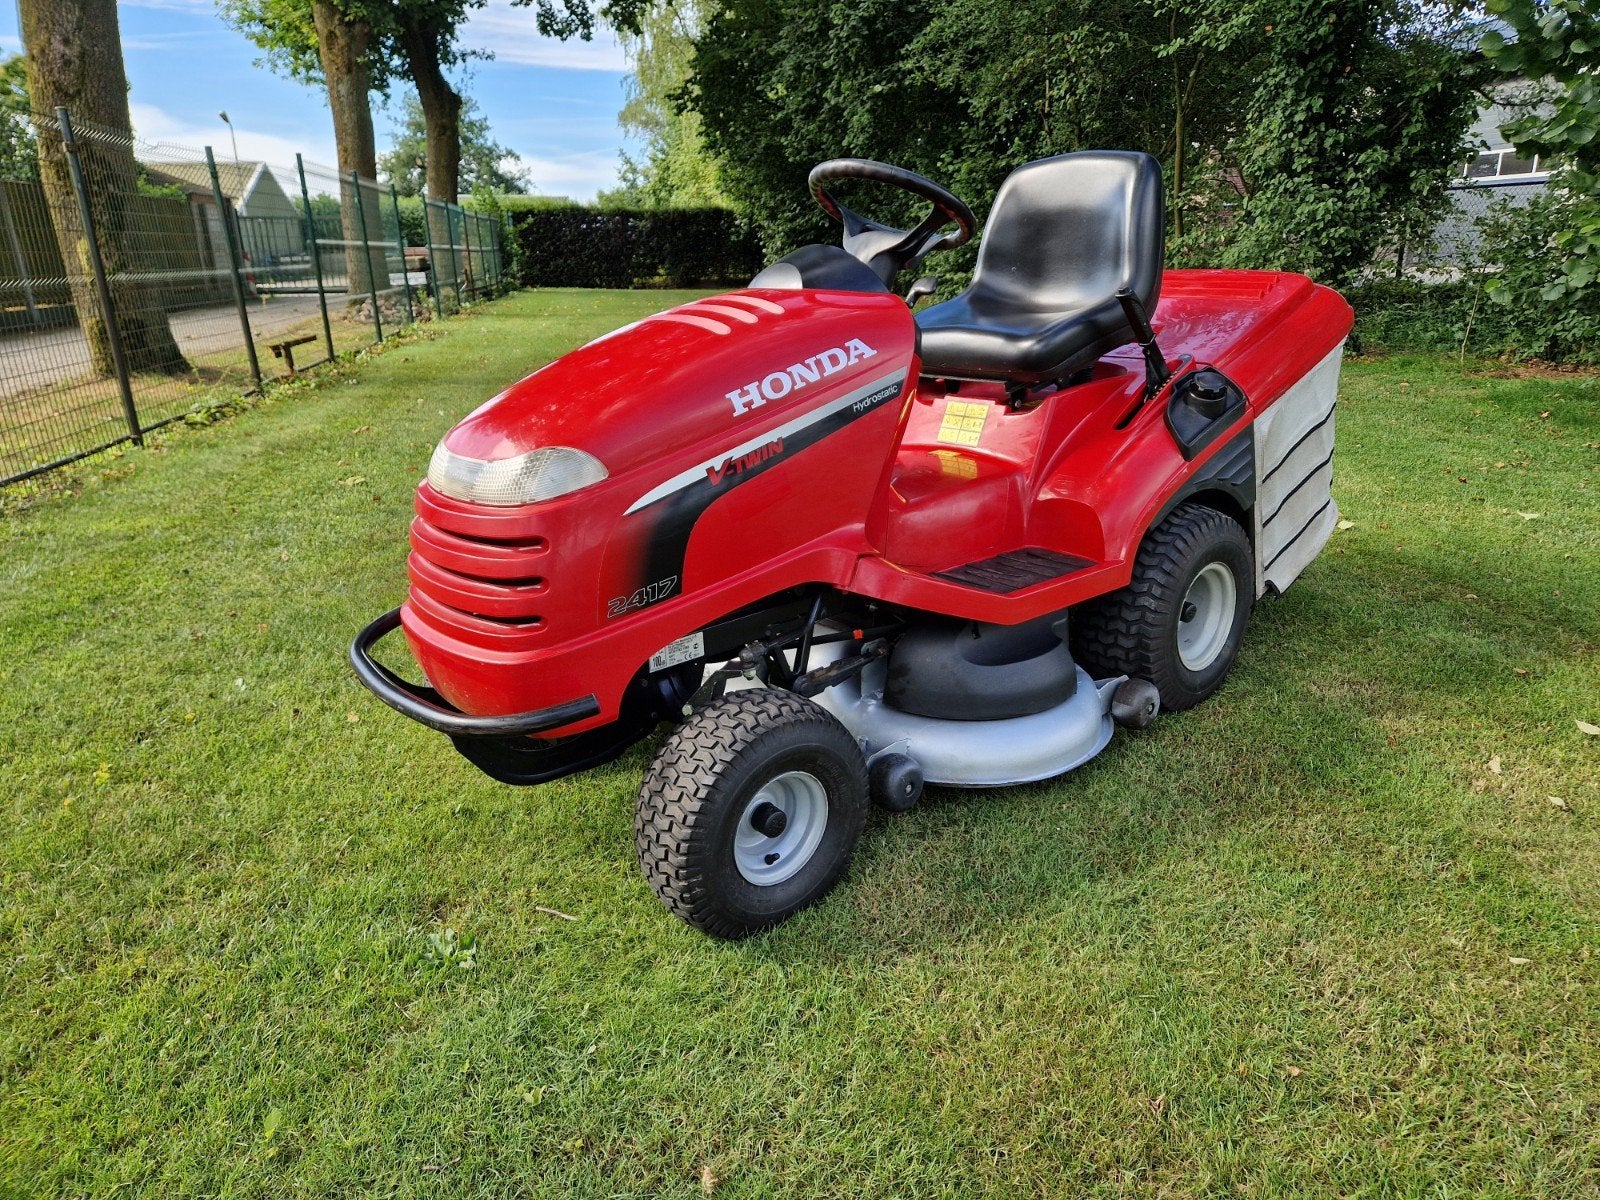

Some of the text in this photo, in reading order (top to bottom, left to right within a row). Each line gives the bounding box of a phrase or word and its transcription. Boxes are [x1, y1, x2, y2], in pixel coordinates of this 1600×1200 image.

[725, 338, 877, 417] HONDA
[852, 384, 898, 413] Hydrostatic
[705, 436, 784, 486] V-TWIN
[607, 575, 678, 618] 2417
